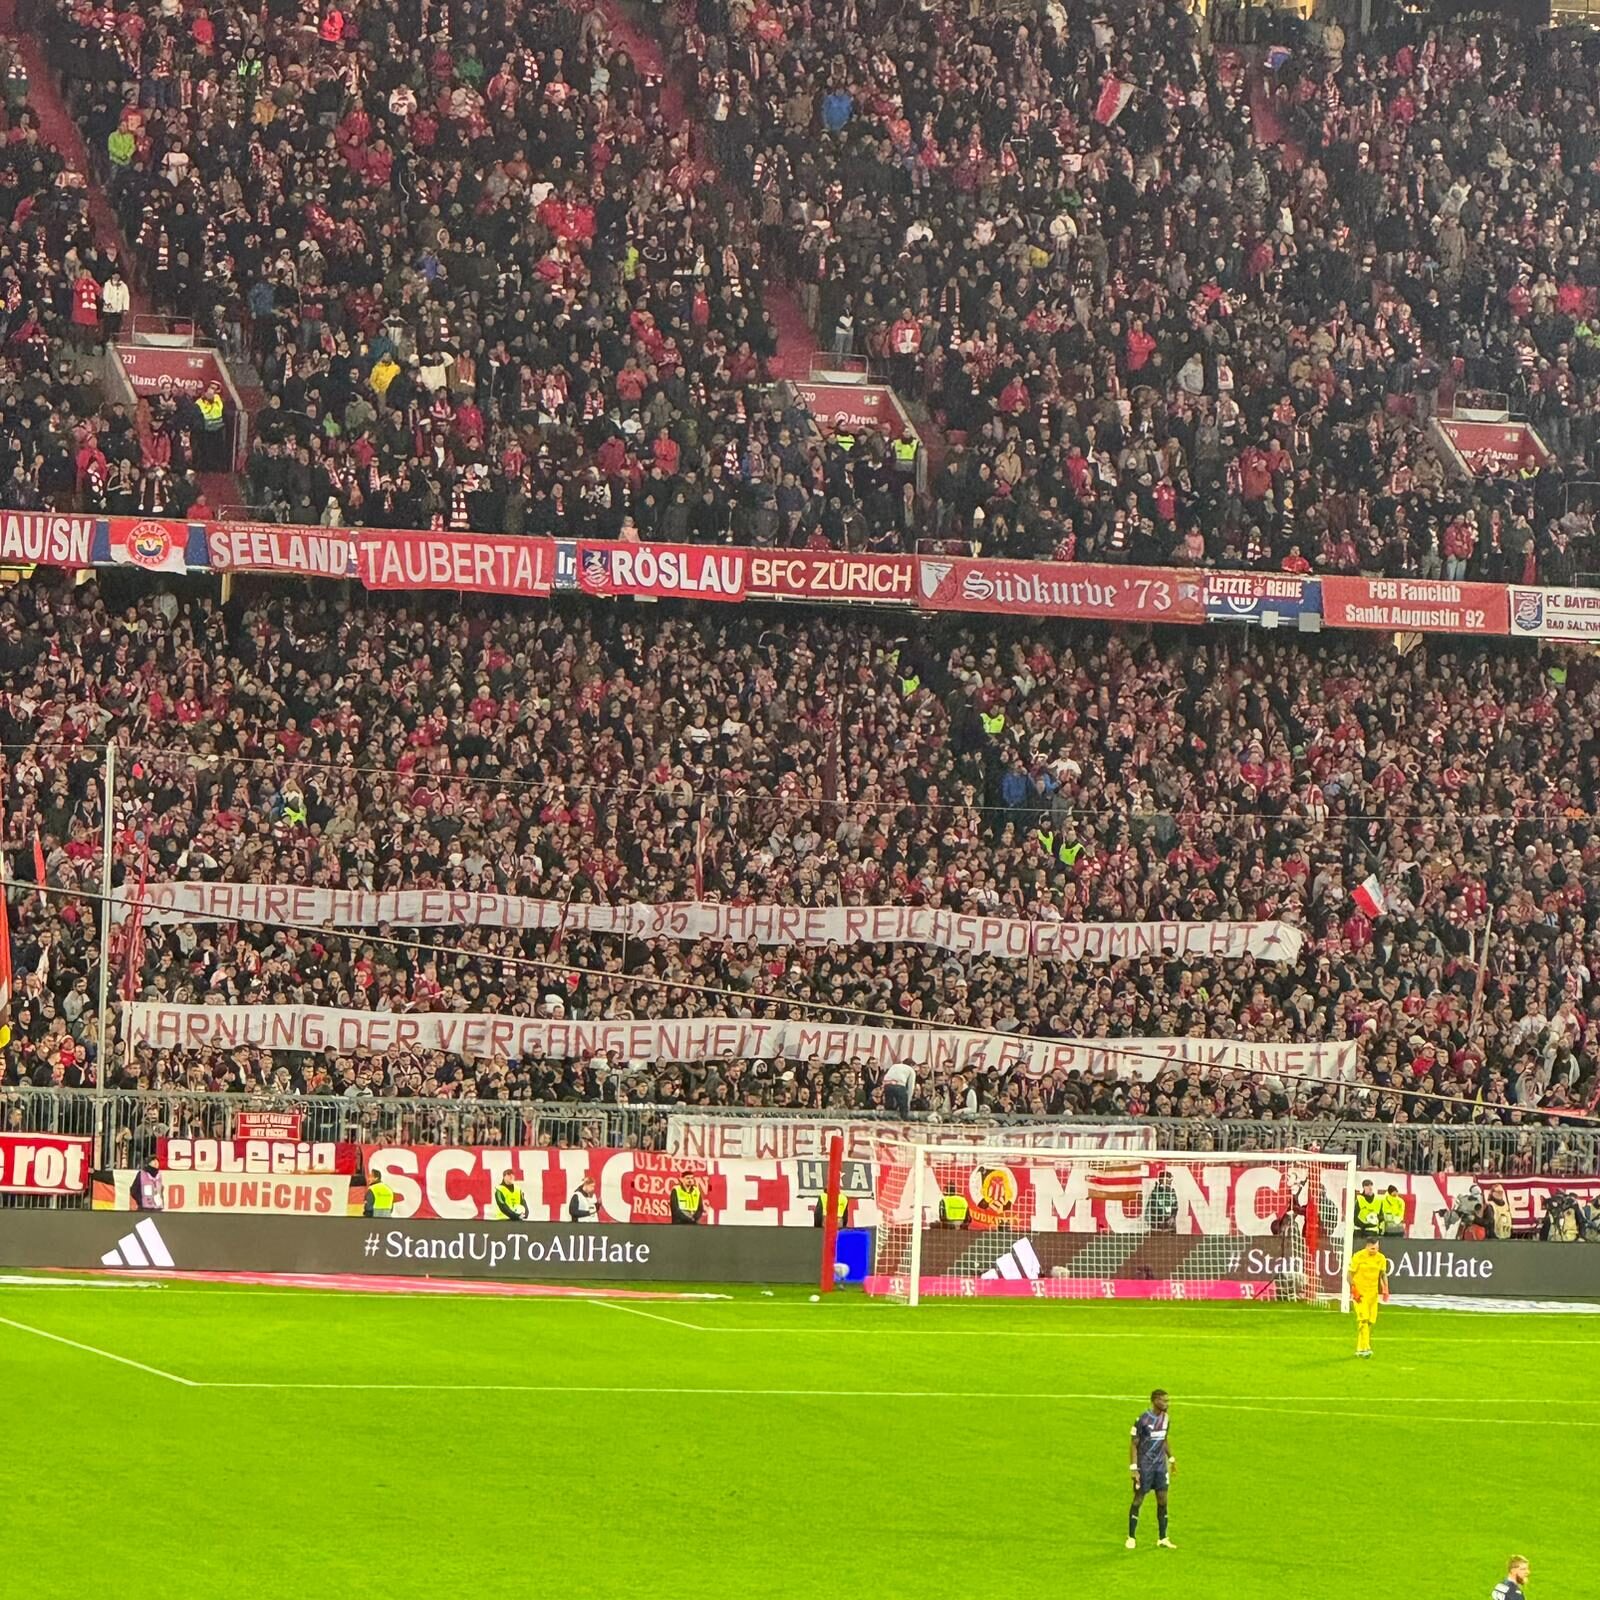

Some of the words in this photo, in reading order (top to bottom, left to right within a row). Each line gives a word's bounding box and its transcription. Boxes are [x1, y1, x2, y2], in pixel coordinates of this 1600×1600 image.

[849, 414, 878, 425] Arena
[0, 515, 91, 563] AU/SN
[210, 532, 349, 575] SEELAND
[360, 541, 550, 590] TAUBERTAL
[612, 547, 743, 594] RÖSLAU
[751, 558, 806, 588] BFC
[810, 559, 912, 592] ZÜRICH
[962, 570, 1118, 608] Südkurve
[1209, 577, 1252, 594] LETZTE
[1266, 580, 1302, 598] REIHE
[1368, 581, 1397, 600] FCB
[1401, 583, 1461, 602] Fanclub
[1546, 594, 1560, 607] FC
[1345, 604, 1388, 623] Sankt
[1546, 619, 1564, 630] BAD
[183, 885, 315, 920] JAHRE
[699, 905, 827, 941] JAHRE
[338, 1018, 421, 1054] DER
[797, 1029, 987, 1073] MAHNUNG
[12, 1144, 84, 1190] rot
[633, 1152, 707, 1172] ULTRAS
[364, 1231, 650, 1267] #StandUpToAllHate
